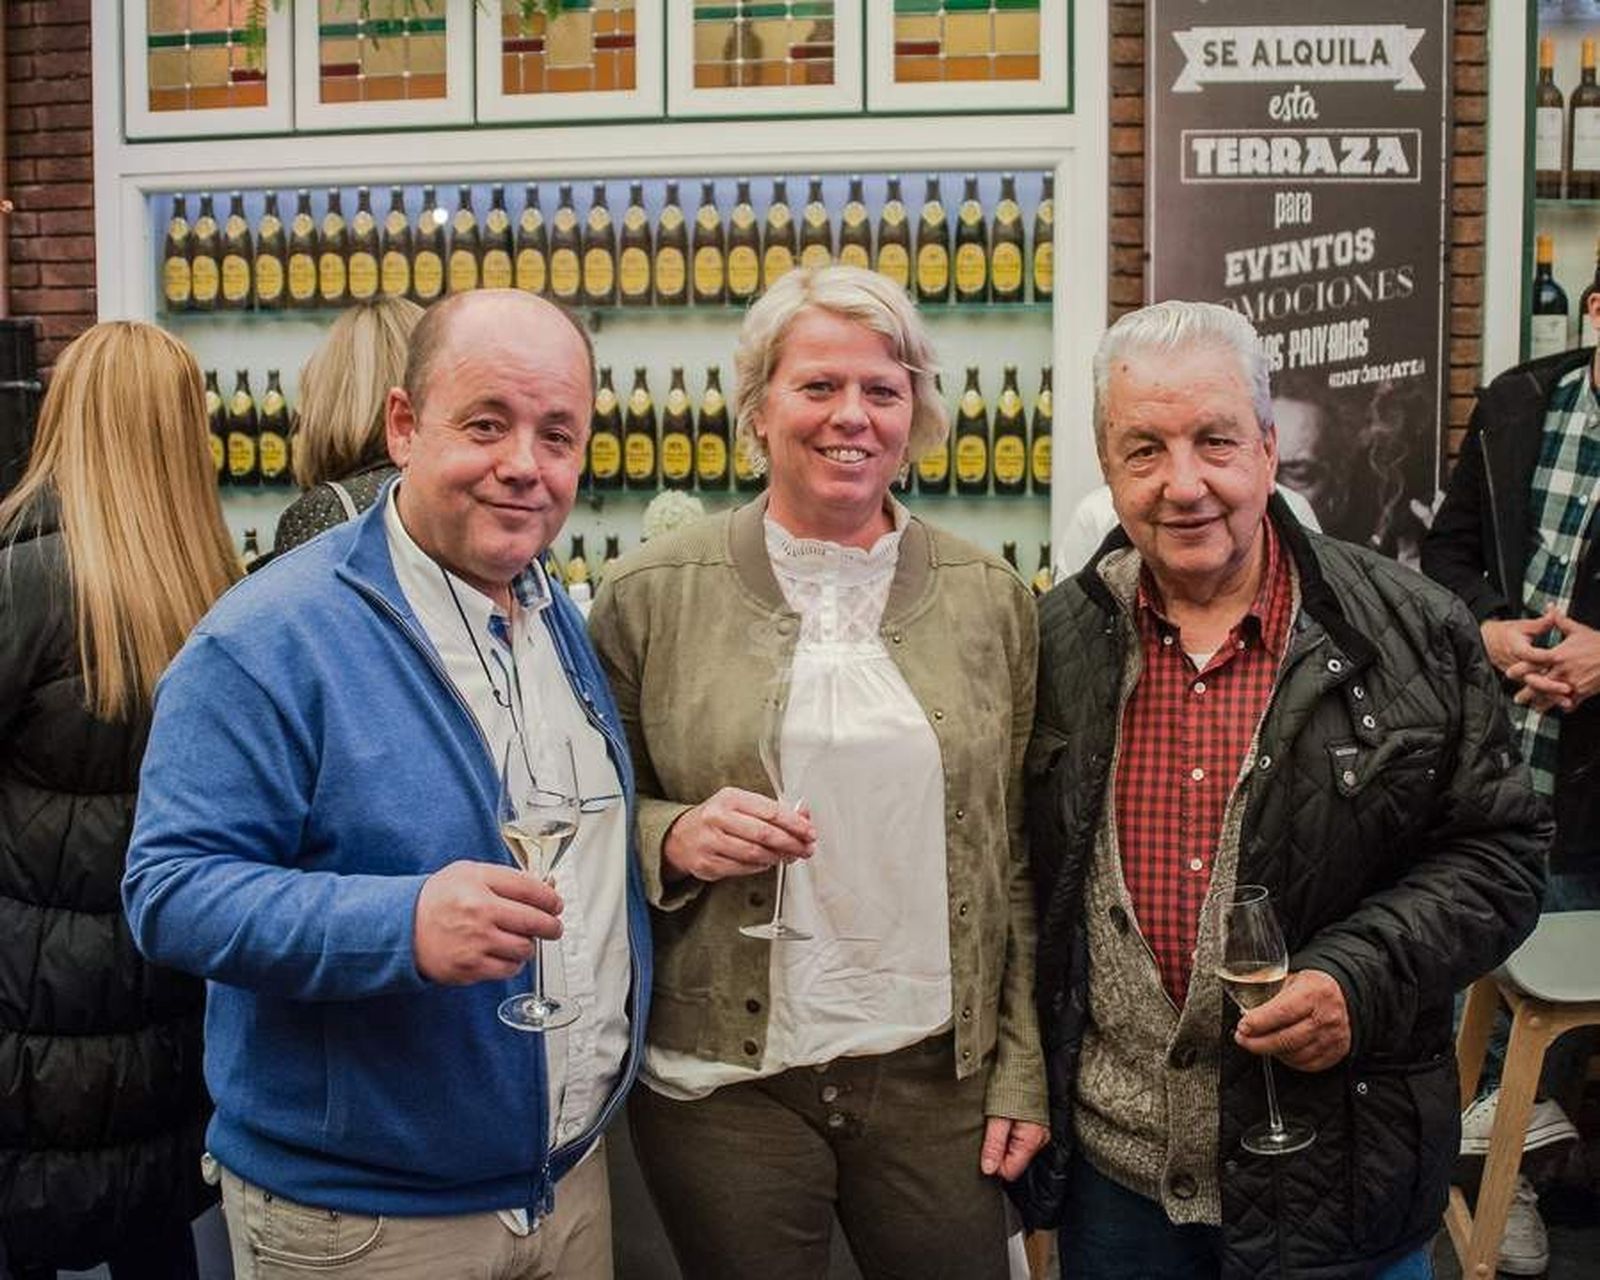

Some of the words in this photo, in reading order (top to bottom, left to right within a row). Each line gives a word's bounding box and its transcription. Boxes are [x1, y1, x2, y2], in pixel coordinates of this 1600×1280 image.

[1203, 40, 1238, 66] SE
[1252, 38, 1389, 66] ALQUILA
[1268, 85, 1319, 121] esta
[1192, 136, 1410, 175] TERRAZA
[1275, 191, 1312, 229] para
[1224, 227, 1376, 287] EVENTOS
[1222, 265, 1415, 322] MOCIONES
